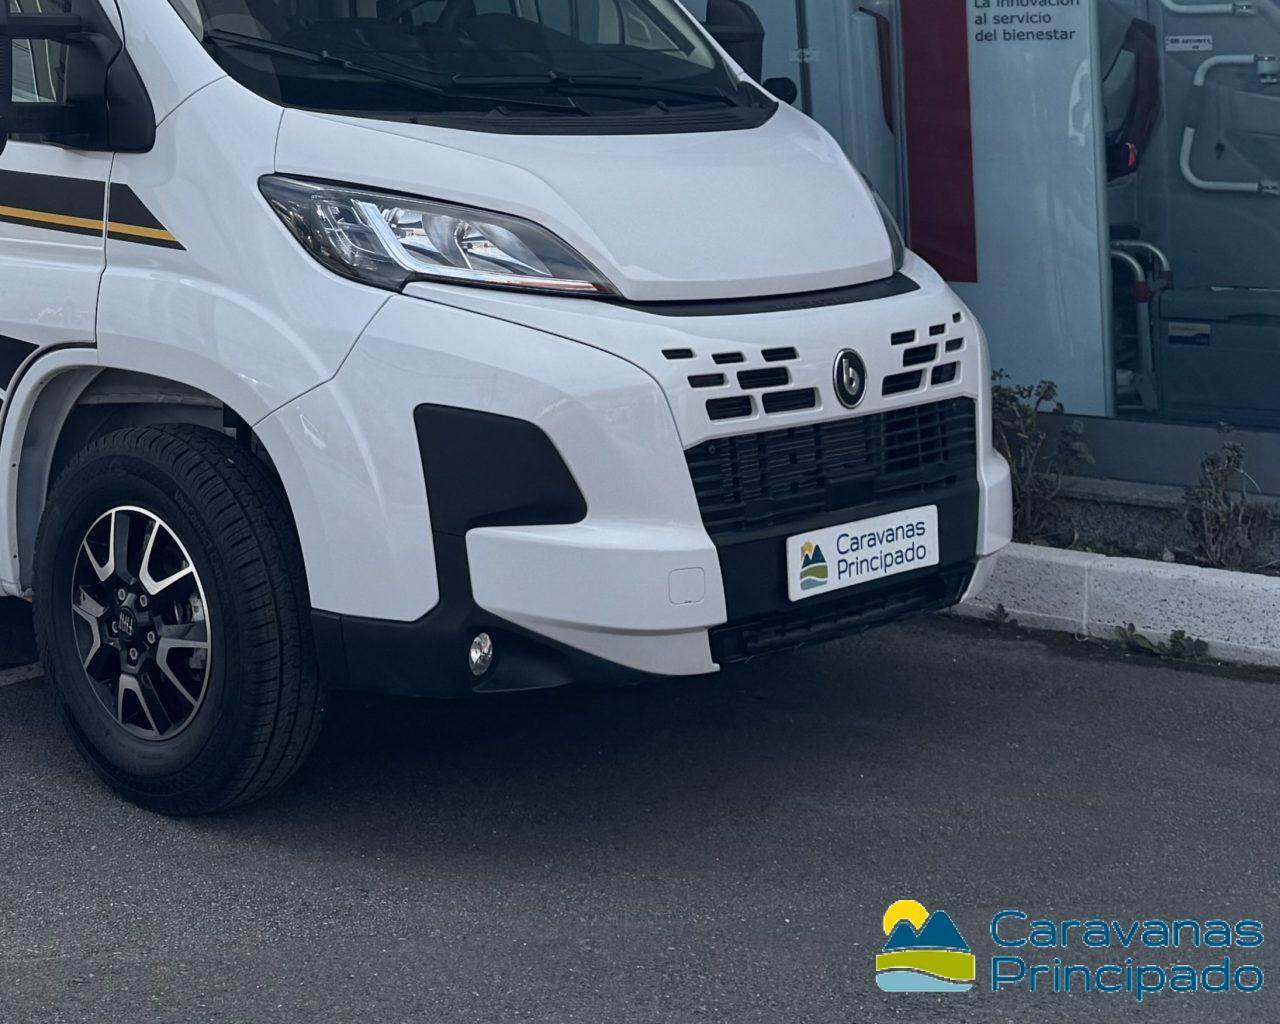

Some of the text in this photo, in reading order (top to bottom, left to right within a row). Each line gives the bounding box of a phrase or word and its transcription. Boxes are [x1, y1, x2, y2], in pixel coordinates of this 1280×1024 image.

[974, 11, 1052, 25] al servicio
[975, 28, 1076, 42] del bienestar
[836, 520, 926, 555] Caravanas
[837, 542, 927, 580] Principado
